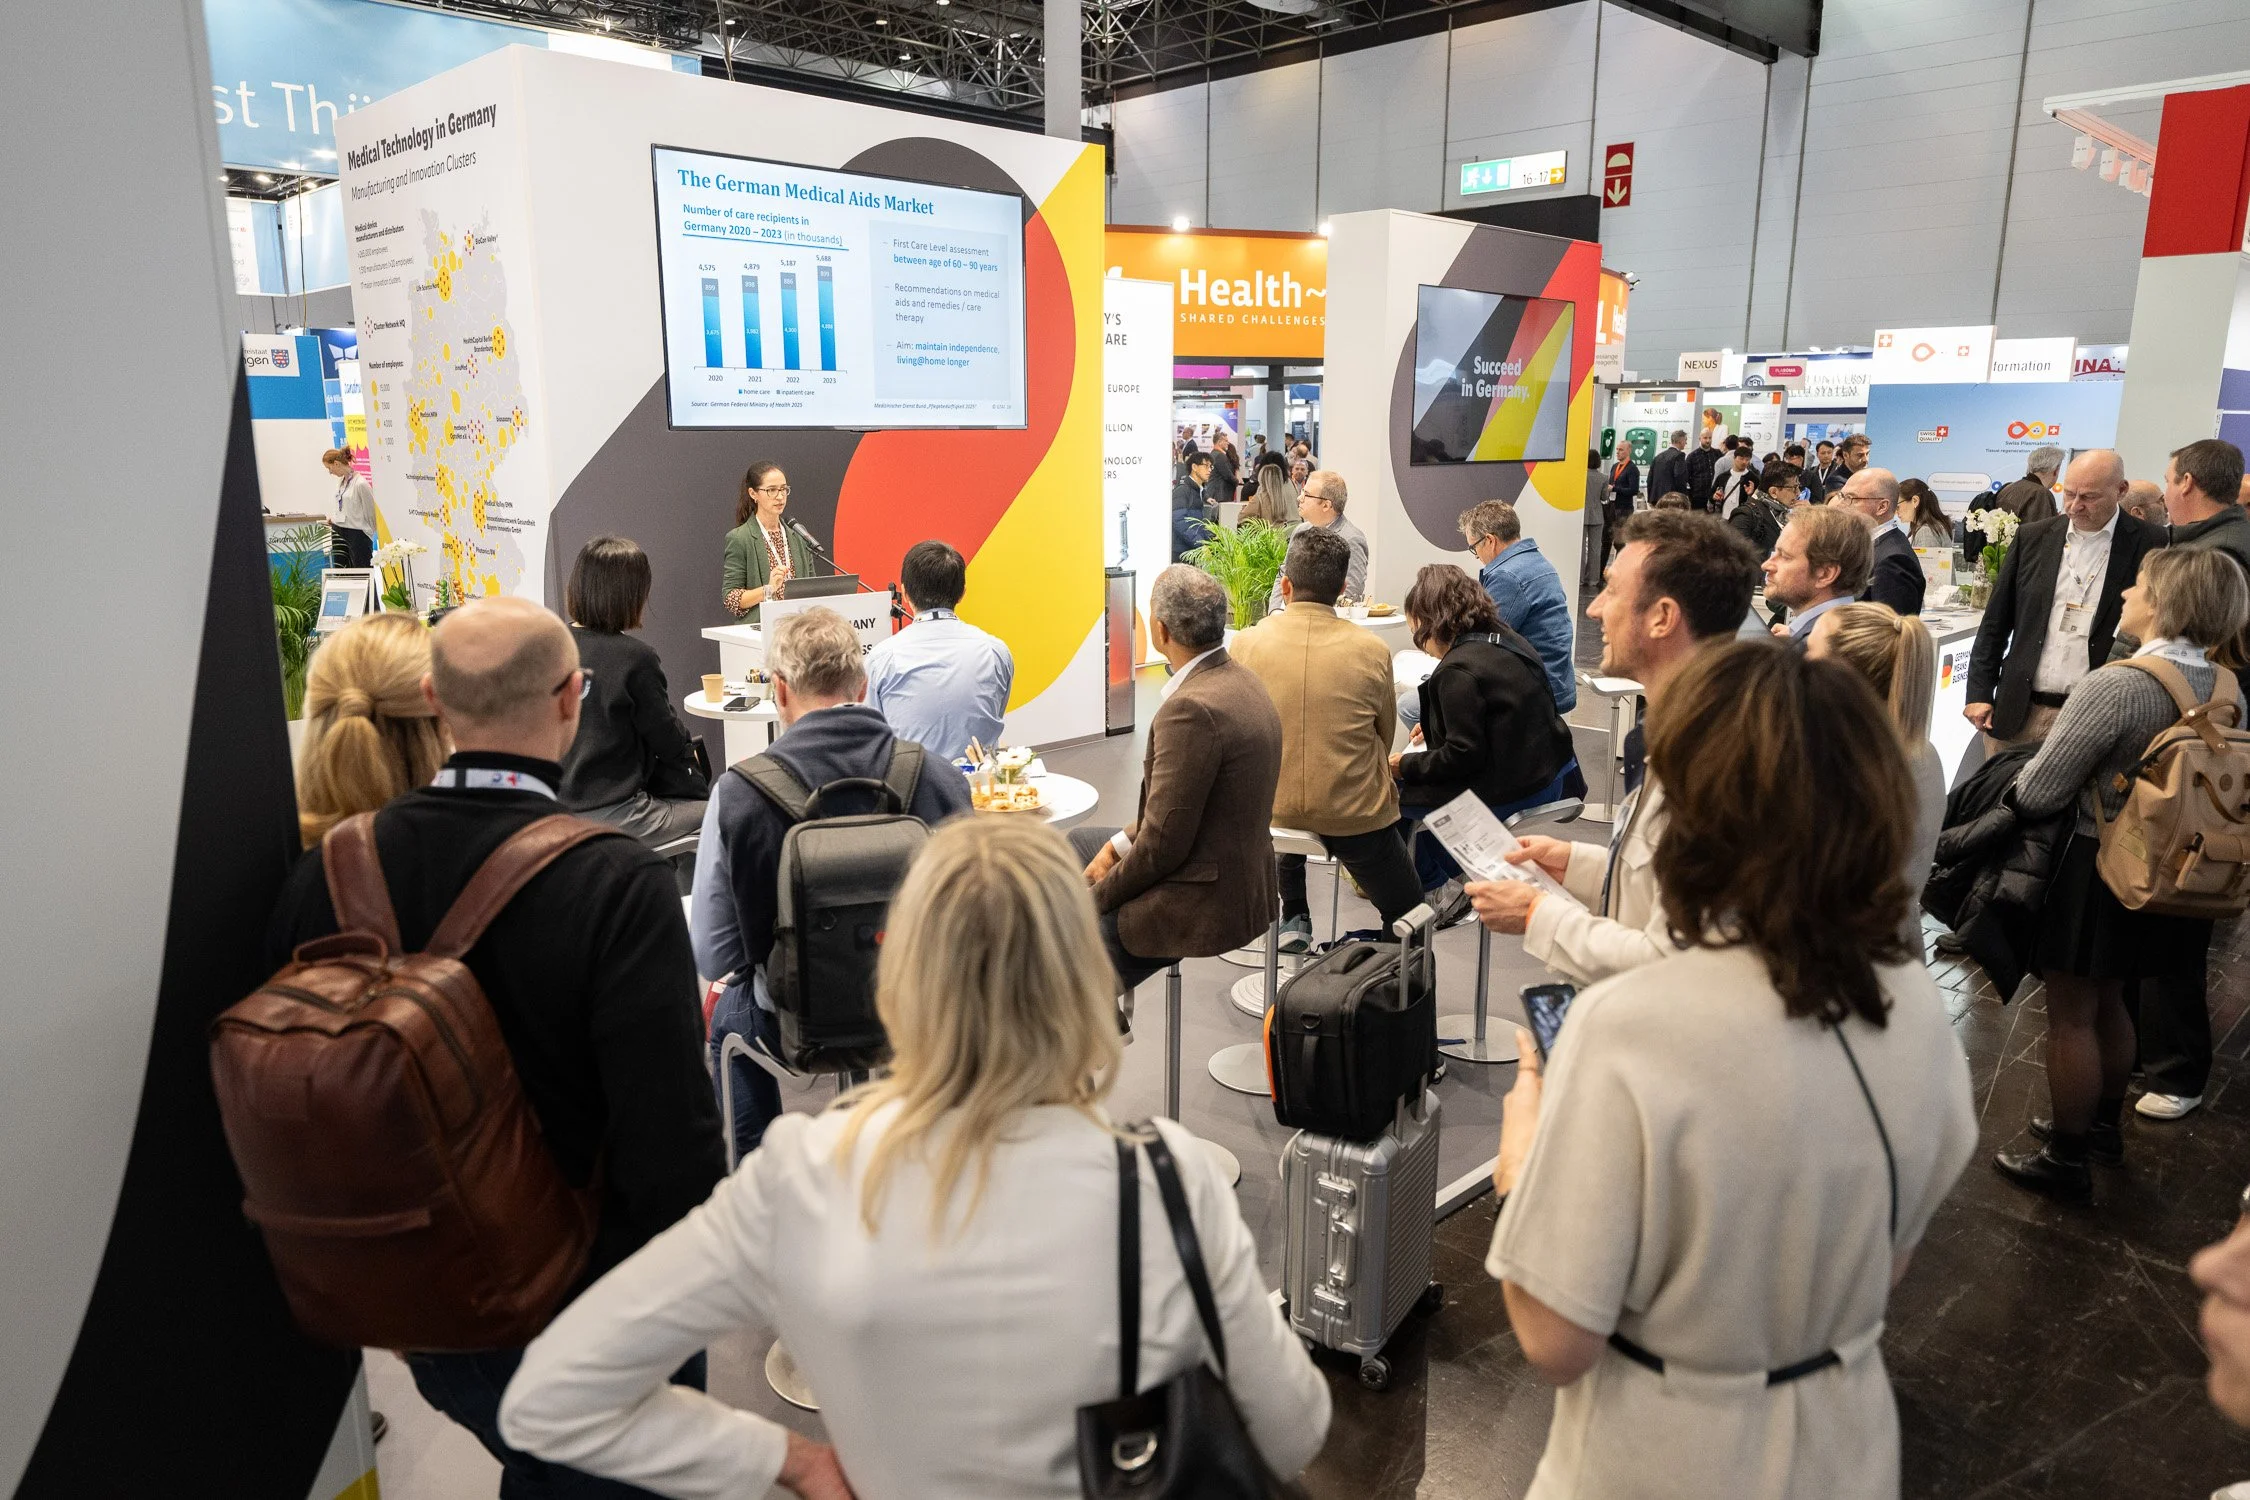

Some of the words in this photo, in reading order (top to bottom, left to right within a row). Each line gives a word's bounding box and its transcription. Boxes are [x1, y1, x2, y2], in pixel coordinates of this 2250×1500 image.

[347, 140, 381, 170] Medical
[381, 126, 434, 158] Technology
[435, 118, 446, 140] in
[447, 104, 497, 135] Germany
[351, 176, 395, 201] Manufacturing
[396, 169, 408, 187] and
[409, 160, 445, 183] Innovation
[446, 151, 477, 172] Clusters
[1523, 172, 1533, 185] 16
[1540, 171, 1549, 183] 17
[677, 169, 711, 189] The
[715, 174, 781, 197] German
[785, 183, 845, 205] Medical
[849, 191, 881, 209] Aids
[884, 195, 934, 215] Market
[683, 203, 721, 217] Number
[723, 208, 733, 218] of
[735, 211, 755, 220] care
[757, 213, 800, 225] recipients
[801, 216, 810, 226] in
[684, 220, 727, 236] Germany
[729, 225, 751, 236] 2020
[761, 228, 782, 239] 2023
[784, 230, 796, 242] (in
[797, 232, 843, 247] thousands)
[893, 239, 909, 249] First
[911, 240, 928, 251] Care
[930, 242, 948, 253] Level
[950, 245, 989, 257] assessment
[893, 254, 927, 266] between
[929, 258, 942, 269] age
[943, 258, 952, 268] of
[952, 259, 962, 269] 60
[969, 261, 978, 270] 90
[979, 263, 998, 272] years
[894, 283, 962, 297] Recommendations
[963, 289, 972, 297] on
[974, 289, 1000, 299] medical
[895, 298, 910, 307] aids
[911, 299, 926, 308] and
[927, 300, 960, 311] remedies
[967, 304, 981, 312] care
[895, 313, 924, 324] therapy
[1180, 312, 1235, 324] SHARED
[1242, 314, 1326, 327] CHALLENGES
[897, 341, 914, 350] Aim:
[915, 342, 948, 352] maintain
[949, 343, 1000, 355] independence,
[897, 356, 945, 367] living@home
[947, 357, 970, 368] longer
[1473, 355, 1522, 376] Succeed
[1684, 359, 1718, 369] NEXUS
[708, 374, 724, 382] 2020
[786, 376, 800, 384] 2022
[1107, 384, 1140, 394] EUROPE
[1461, 378, 1473, 397] in
[1475, 379, 1530, 403] Germany.
